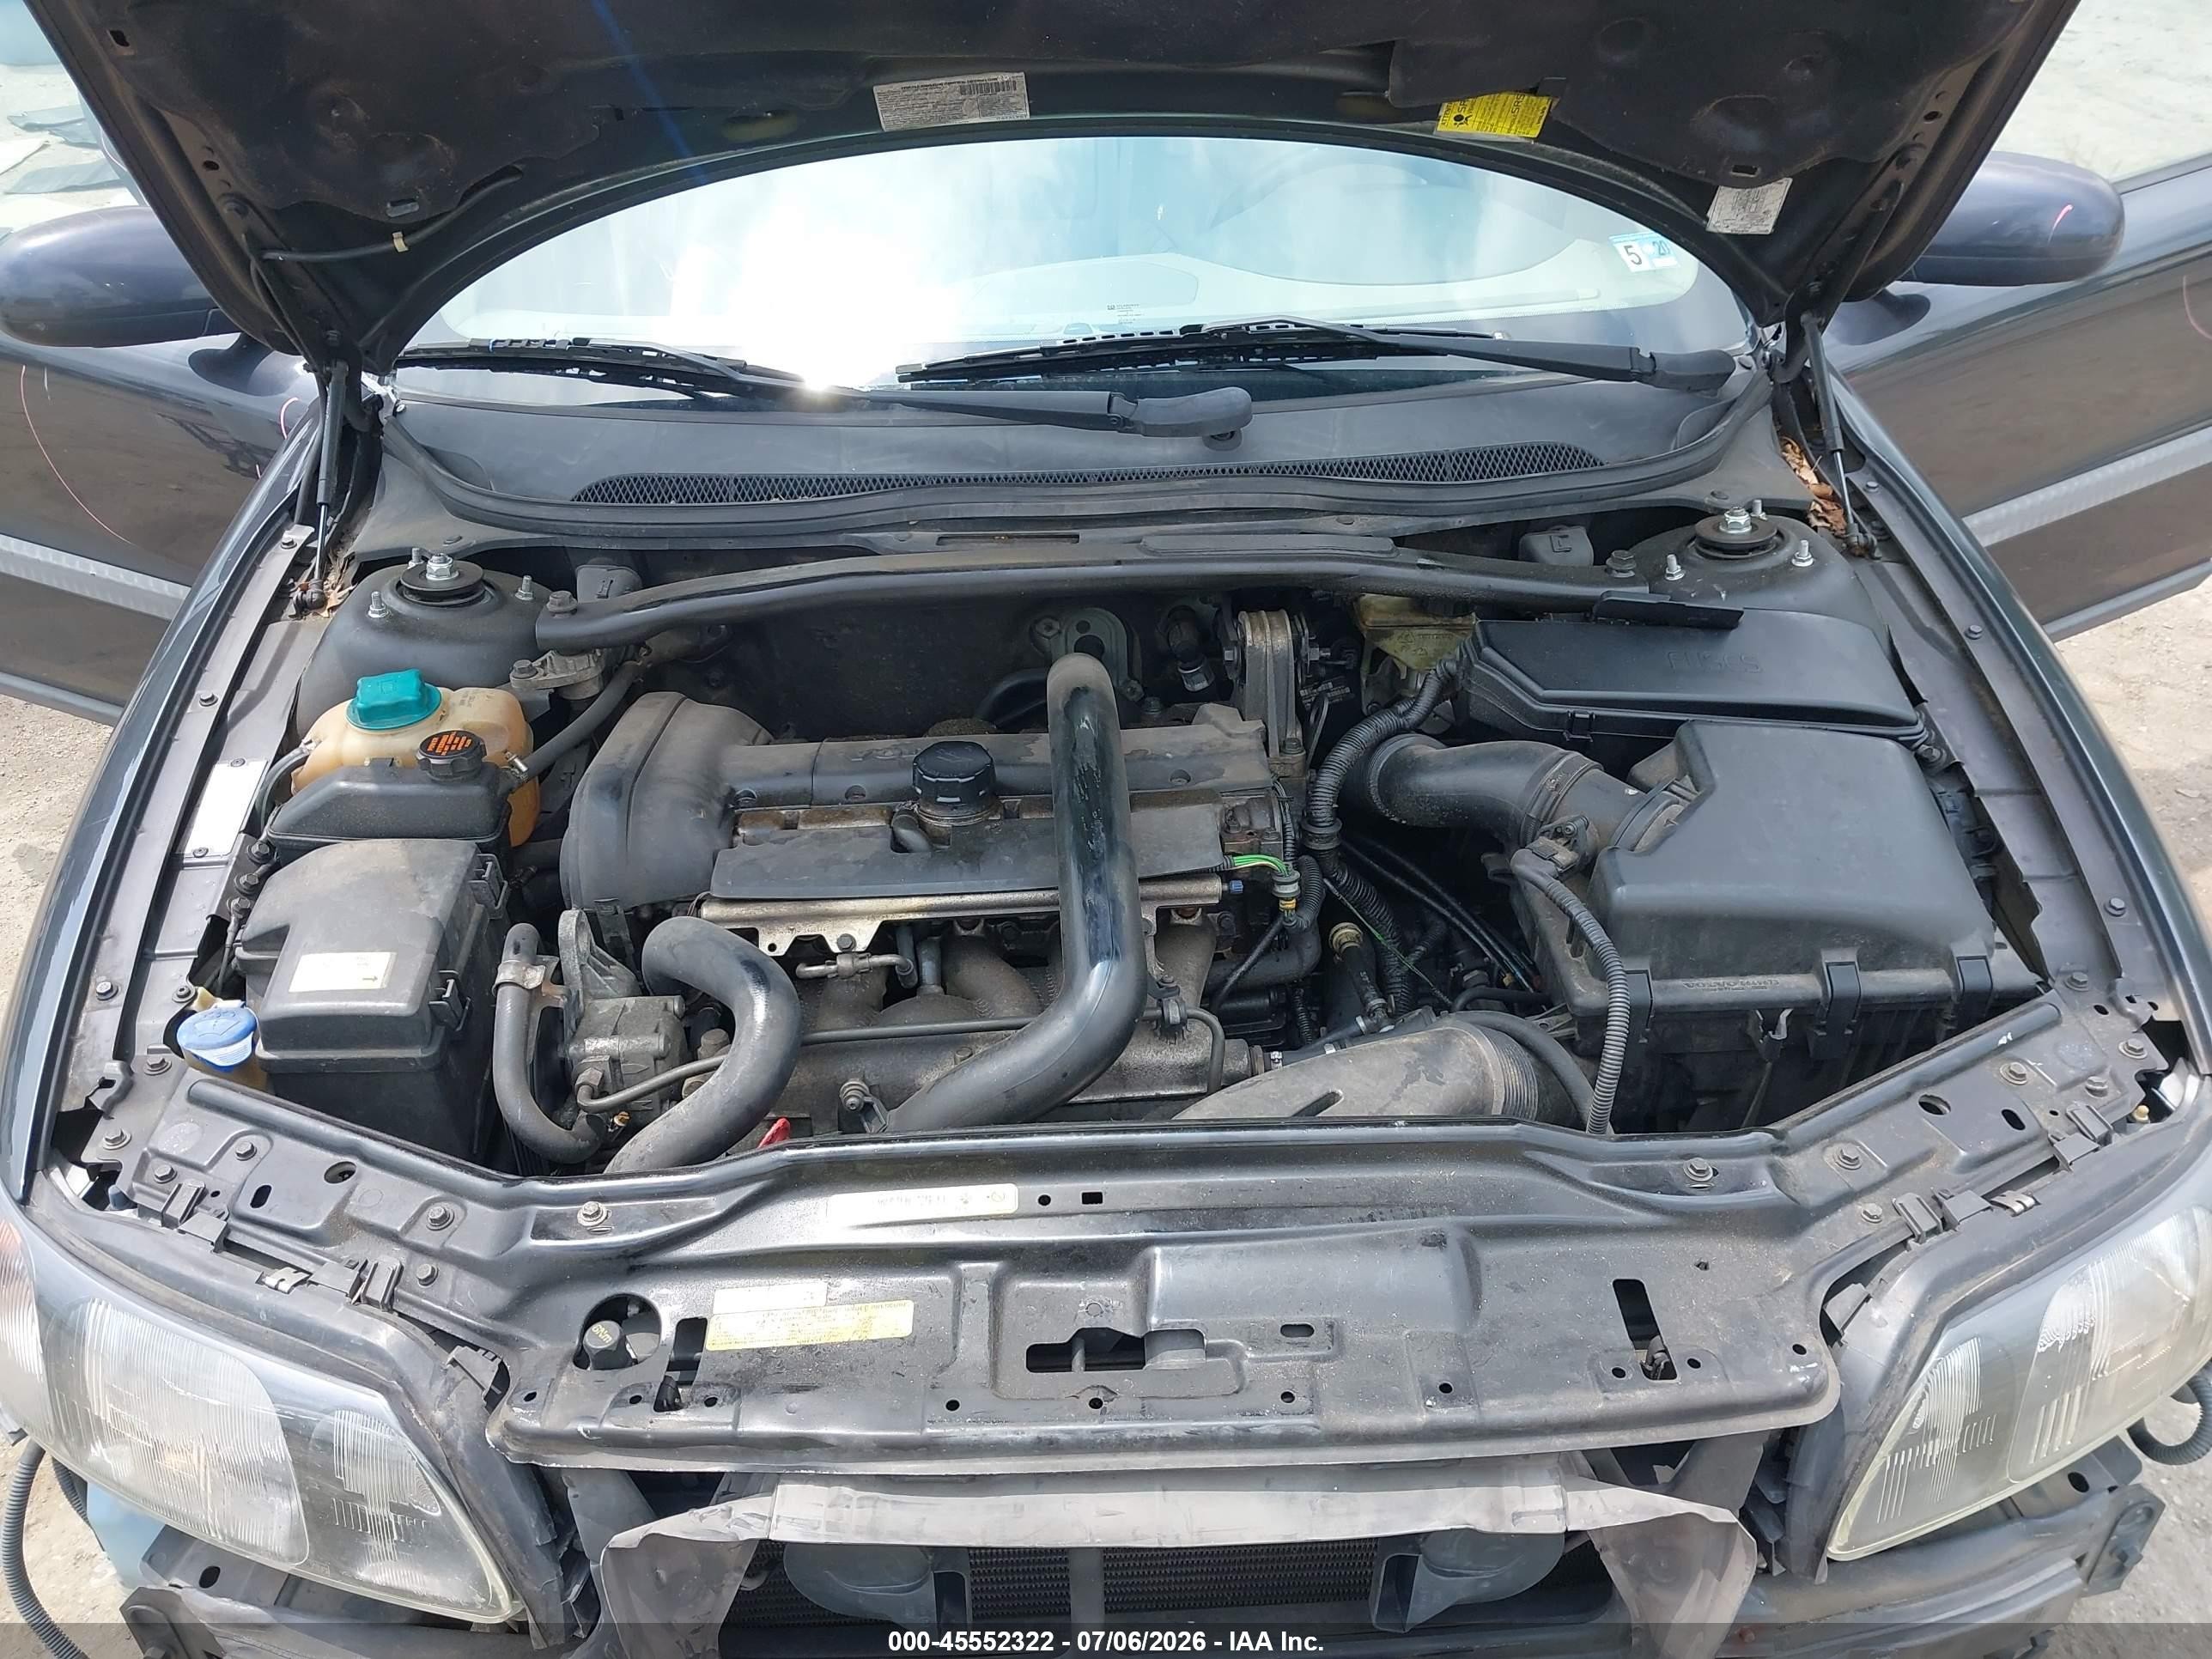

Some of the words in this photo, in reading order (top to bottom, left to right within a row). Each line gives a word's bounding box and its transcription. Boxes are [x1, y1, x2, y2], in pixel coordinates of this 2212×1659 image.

[1511, 94, 1525, 114] SRS
[1623, 245, 1643, 265] 5
[1666, 650, 1763, 674] FUSES
